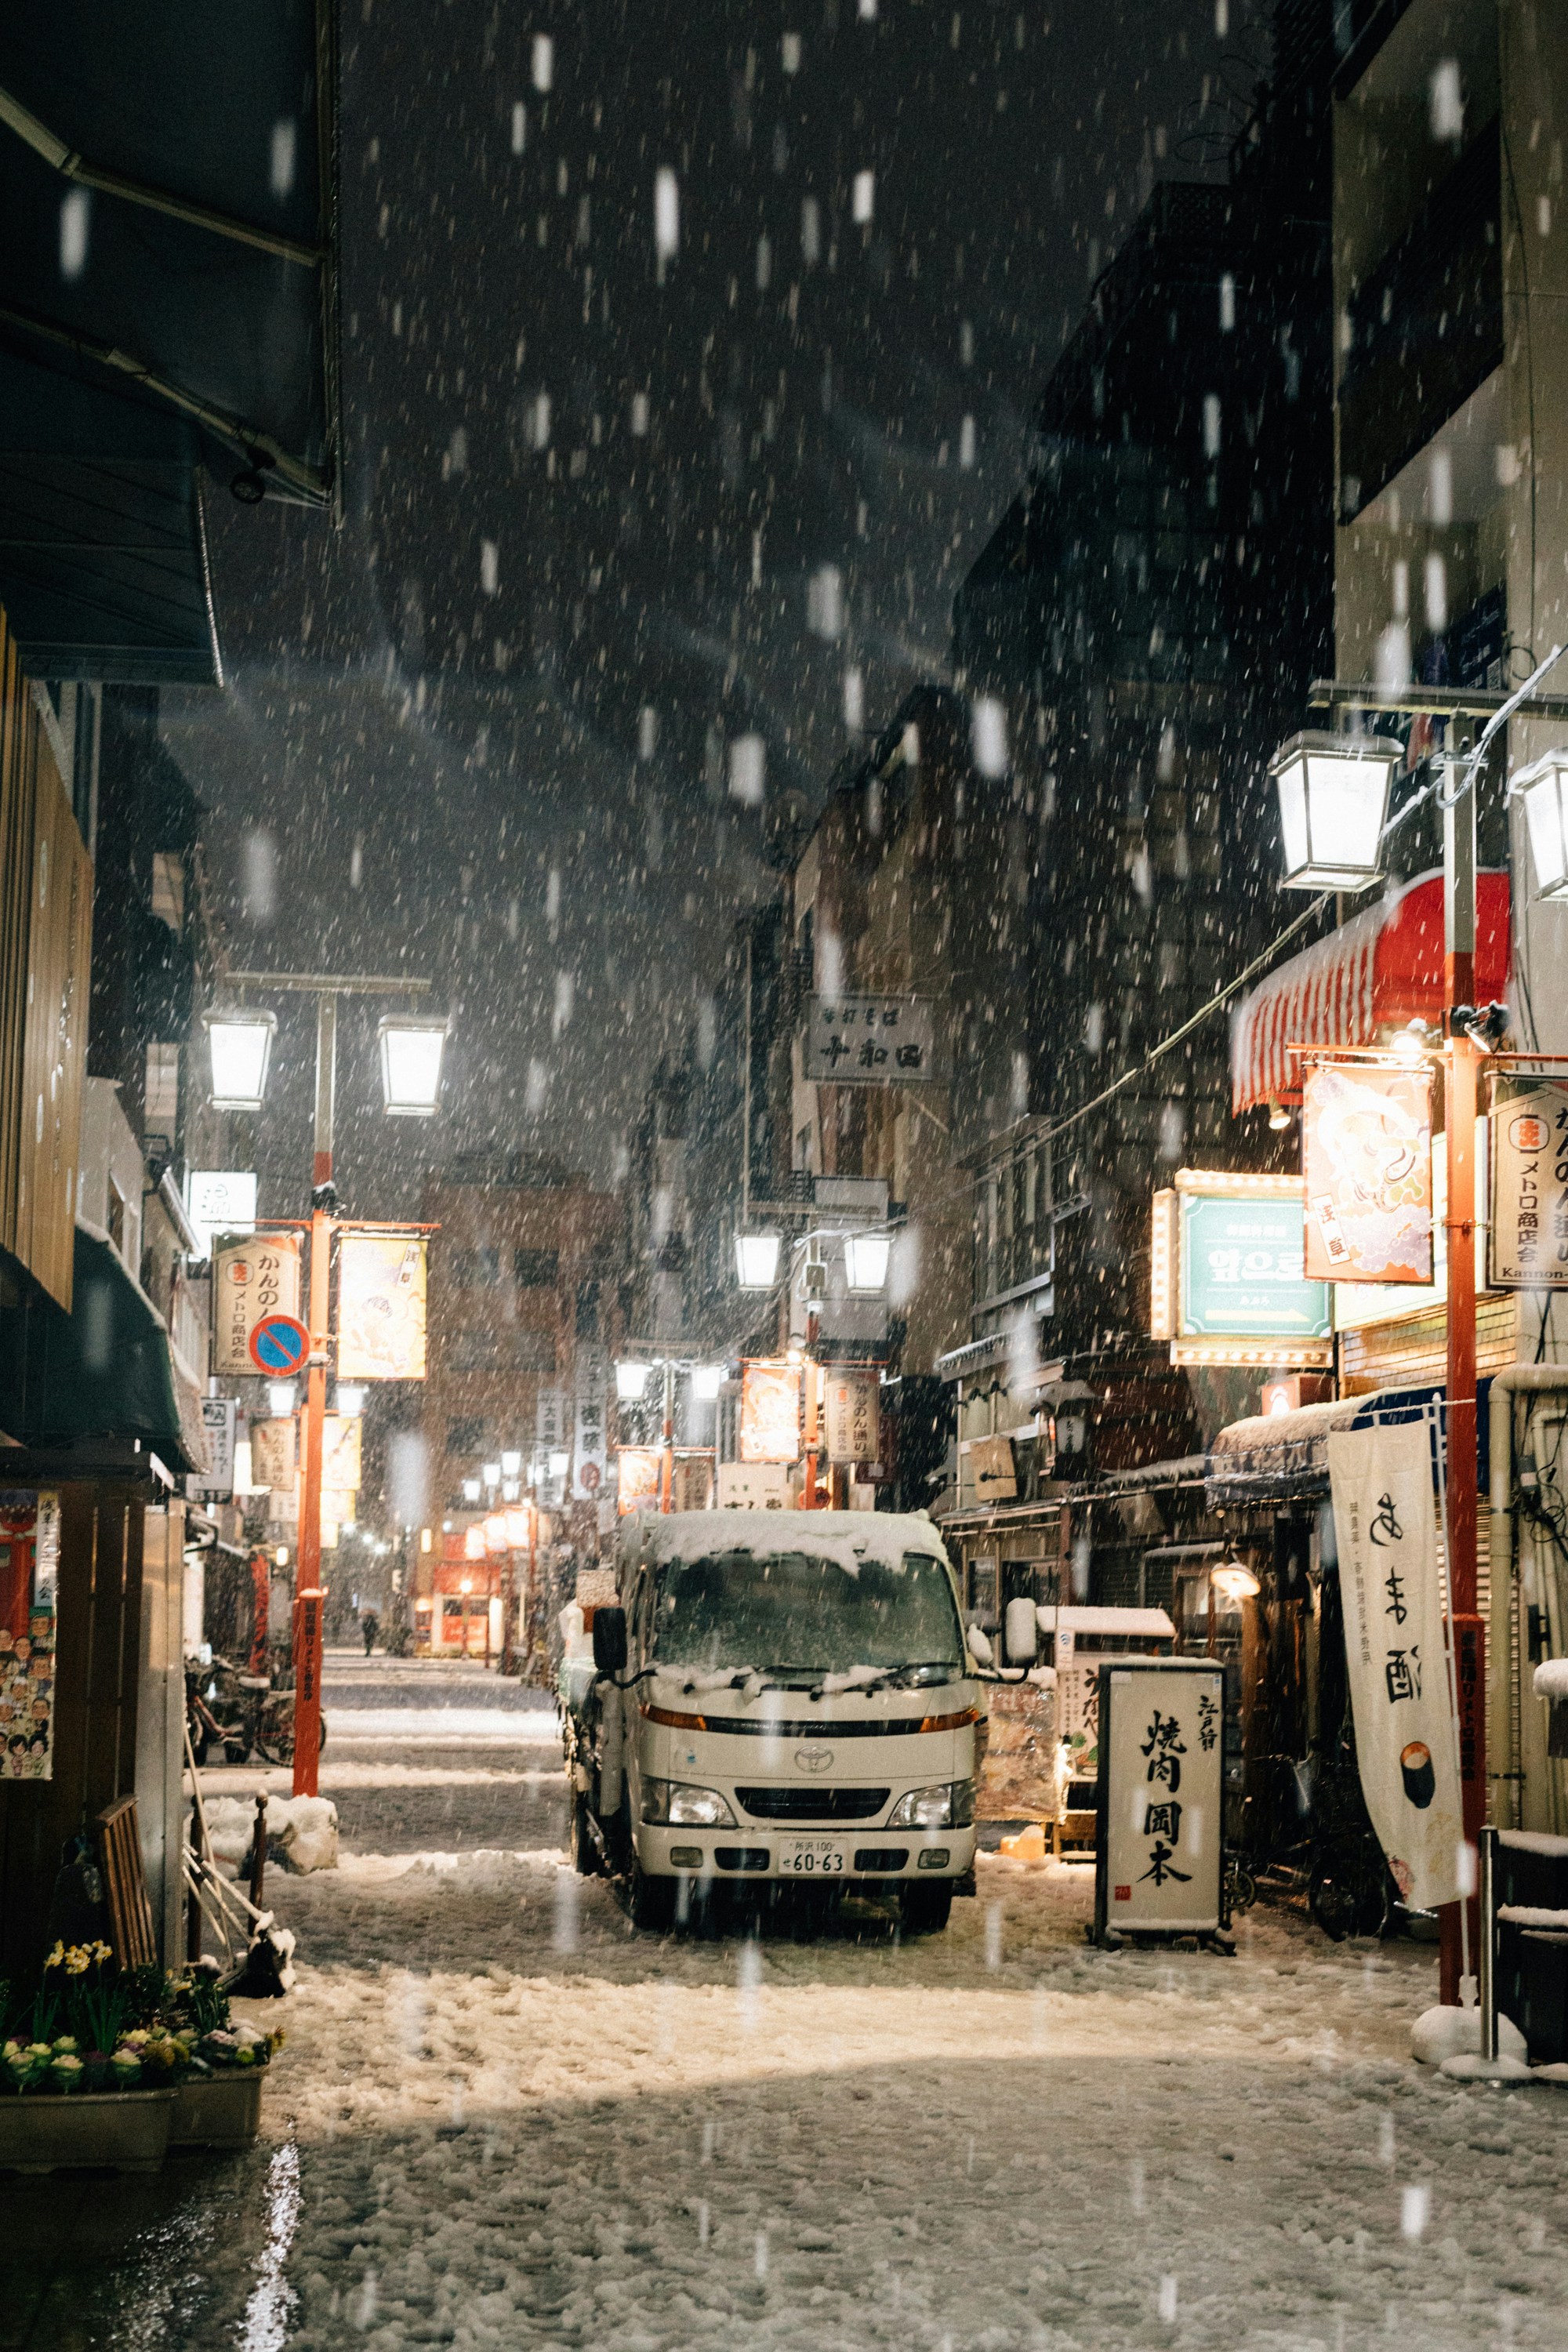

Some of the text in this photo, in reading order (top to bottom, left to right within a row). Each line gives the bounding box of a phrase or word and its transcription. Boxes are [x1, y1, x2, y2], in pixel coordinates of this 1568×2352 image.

[820, 1035, 923, 1069] 十和田
[1320, 1204, 1345, 1257] 浅草
[1517, 1161, 1539, 1262] メトロ商店会
[231, 1290, 246, 1358] メトロ商店会
[854, 1384, 867, 1452] かんのん通り
[1198, 1695, 1218, 1751] 江戸前
[793, 1854, 843, 1871] 60-63
[816, 1842, 832, 1851] 100
